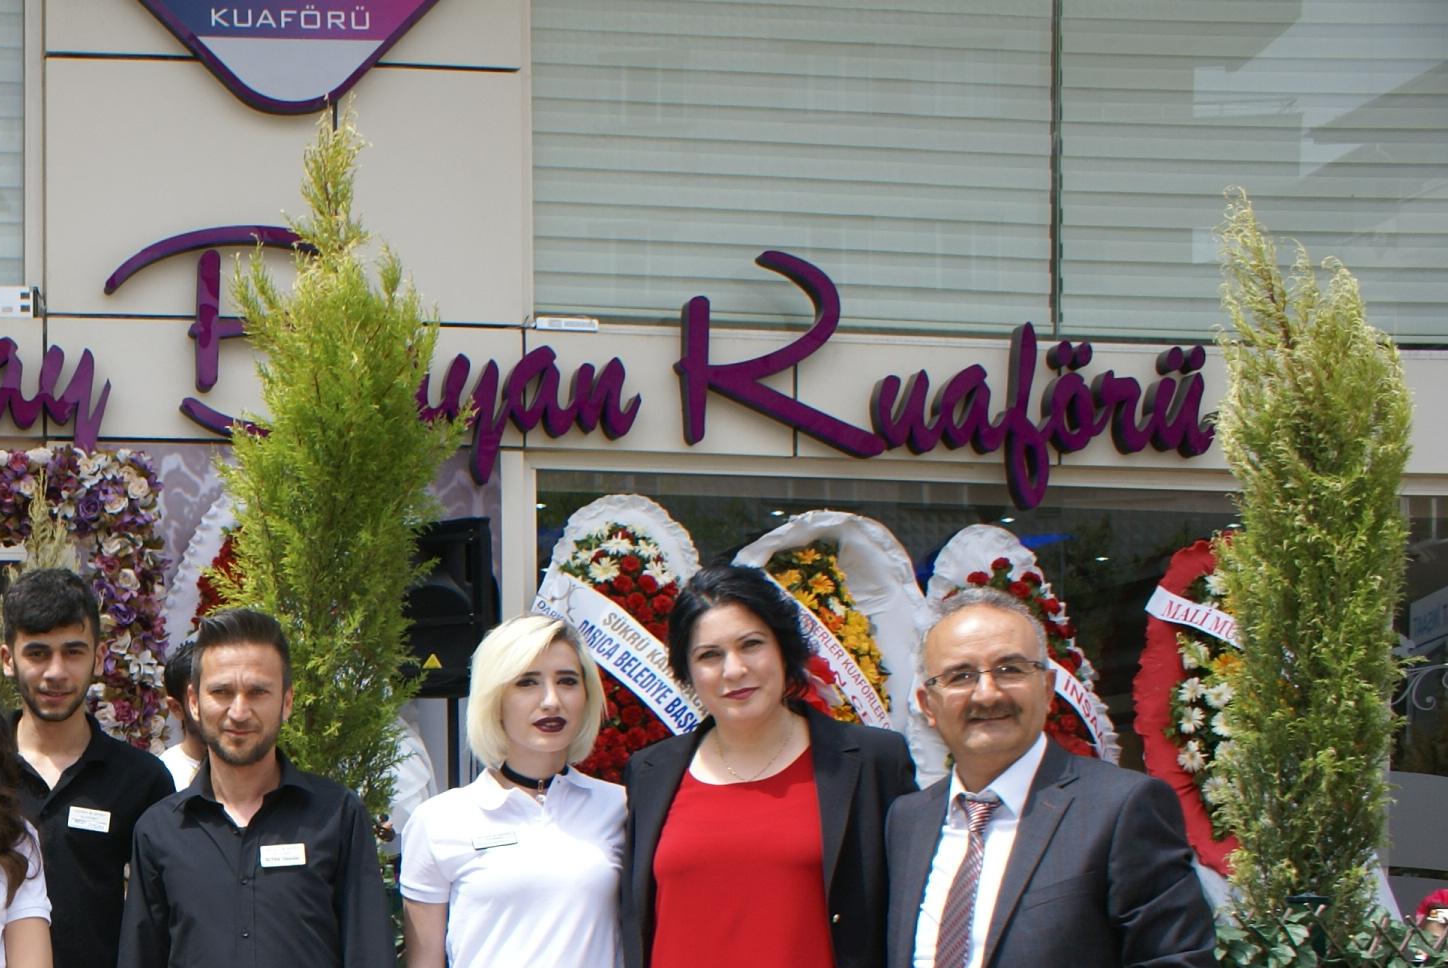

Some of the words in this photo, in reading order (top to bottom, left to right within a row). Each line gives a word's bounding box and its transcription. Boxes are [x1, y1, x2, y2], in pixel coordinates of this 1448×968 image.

[210, 5, 370, 30] KUAFÖRÜ
[104, 224, 642, 486] Byan
[672, 250, 1222, 511] Kuaförü
[1161, 600, 1212, 626] MALİ
[578, 619, 620, 661] DARICA
[613, 650, 673, 705] BELEDİYE
[664, 696, 702, 734] BAŞK
